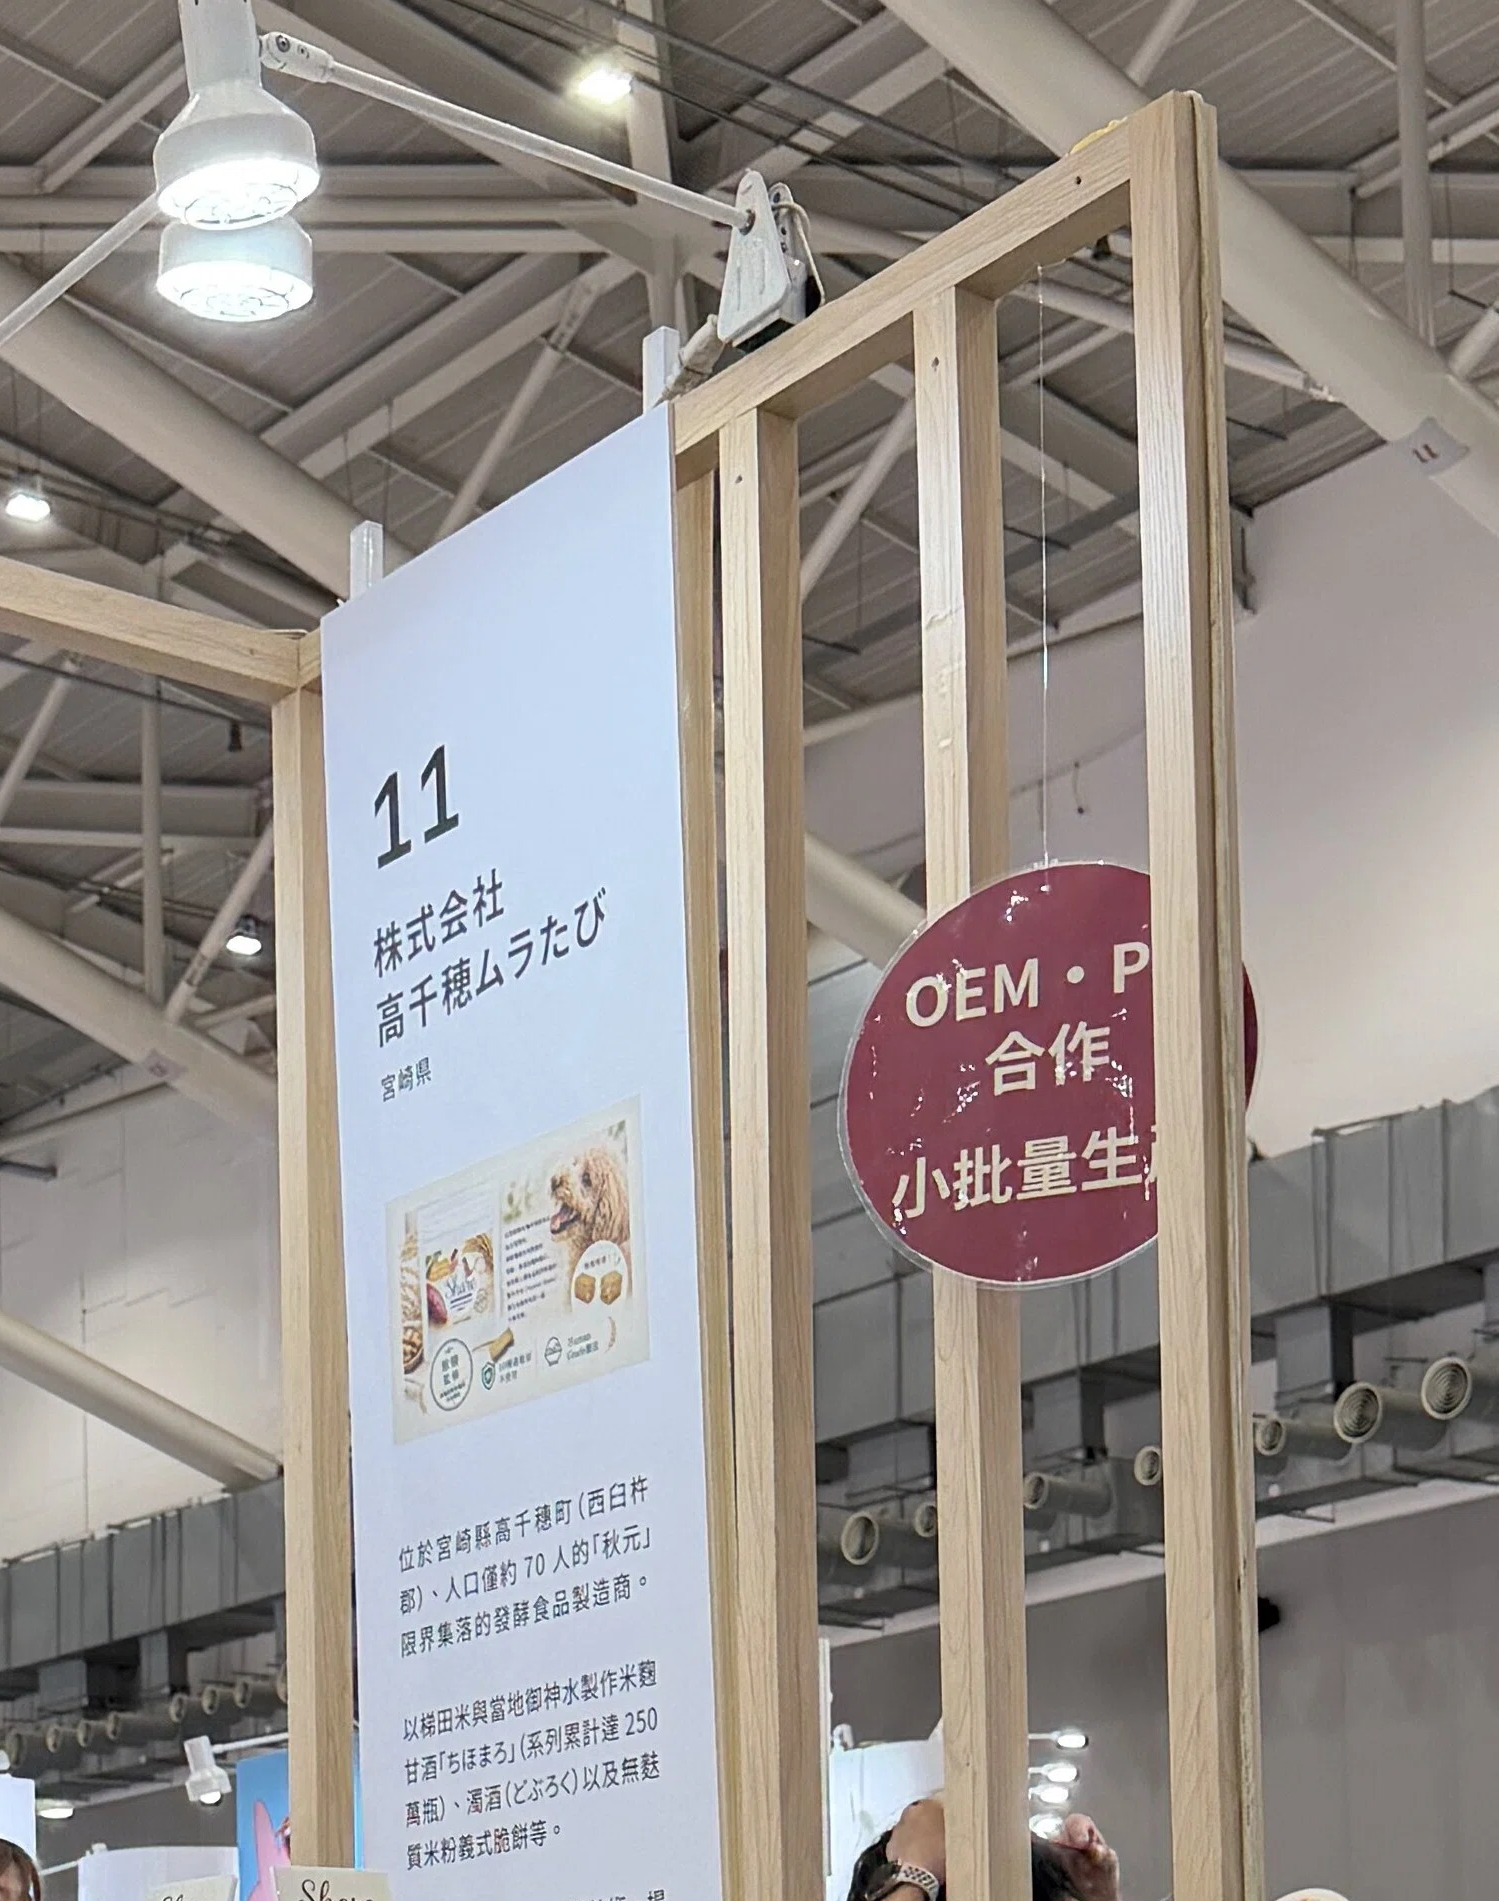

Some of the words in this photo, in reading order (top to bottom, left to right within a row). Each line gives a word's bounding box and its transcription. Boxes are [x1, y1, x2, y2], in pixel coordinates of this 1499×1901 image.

[374, 744, 459, 868] 11
[374, 869, 504, 977] 株式会社
[377, 887, 607, 1048] 高千穂ムラたび
[381, 1057, 432, 1101] 宮崎県
[985, 1021, 1111, 1096] 合作
[892, 1126, 1157, 1219] 小批量生
